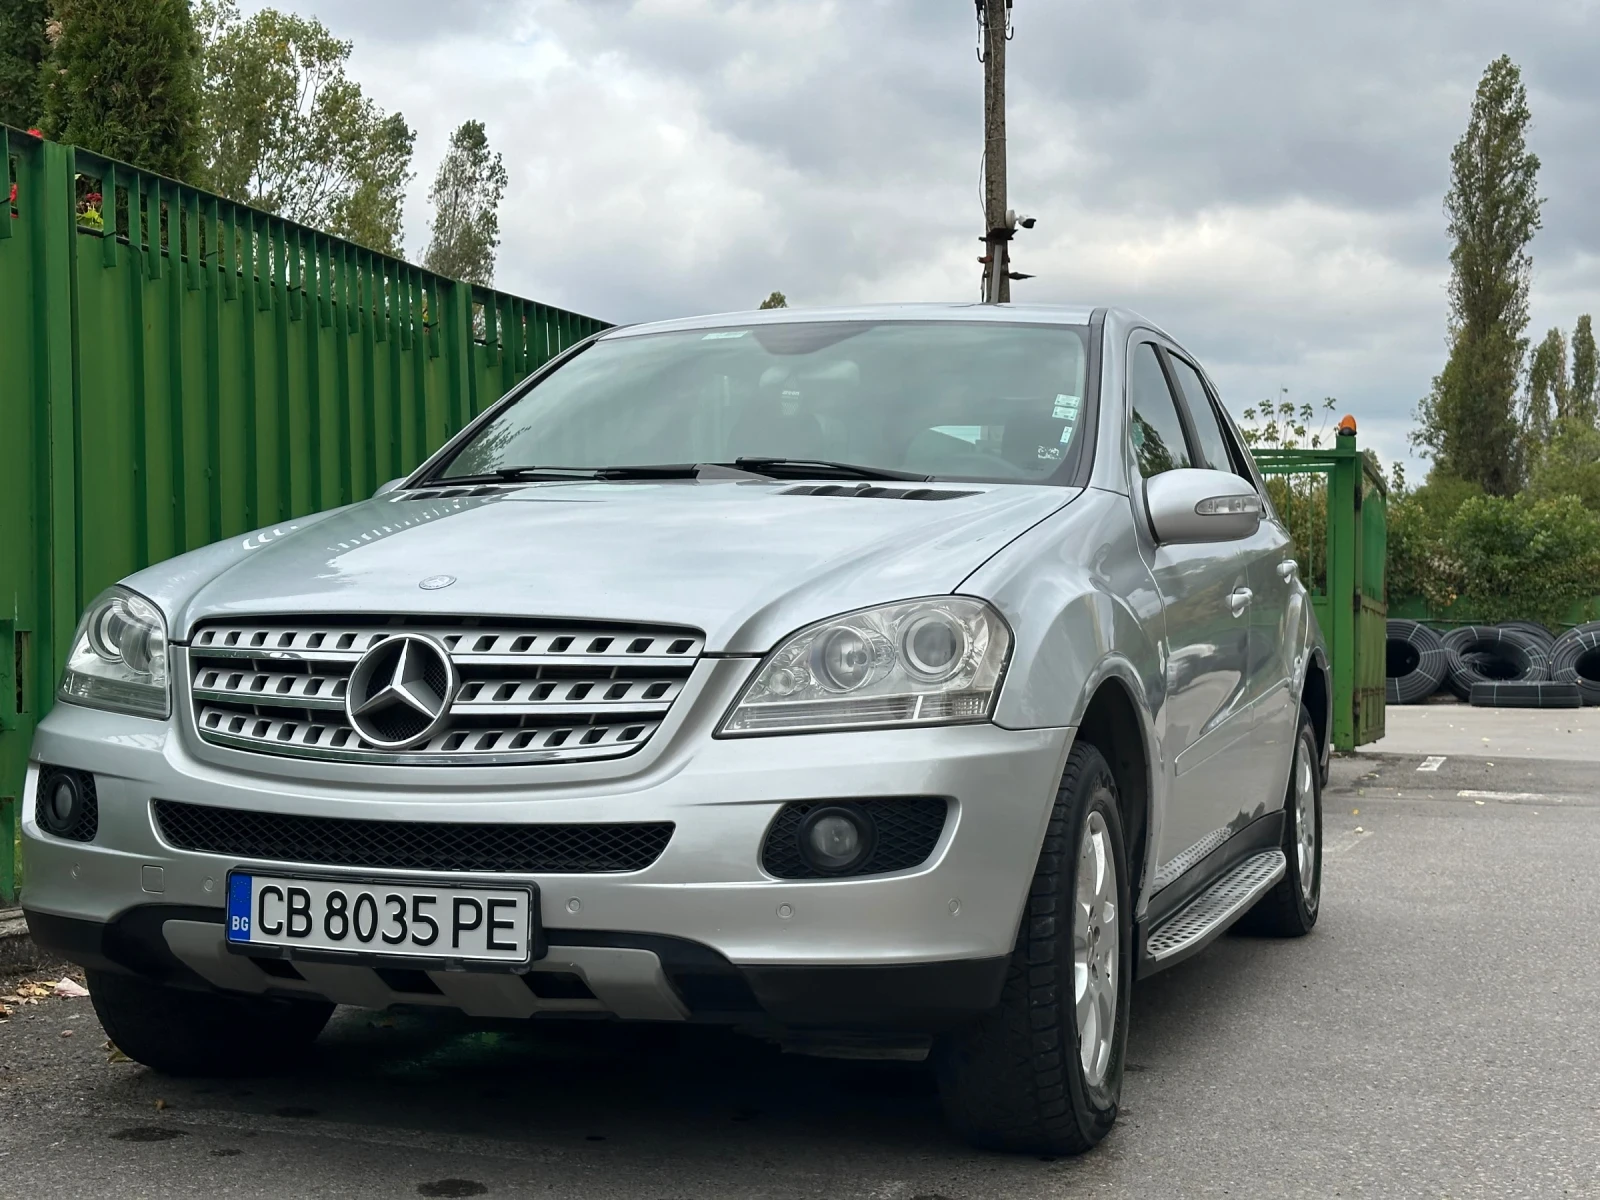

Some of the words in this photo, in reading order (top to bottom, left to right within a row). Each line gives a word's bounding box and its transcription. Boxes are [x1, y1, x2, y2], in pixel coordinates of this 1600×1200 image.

[232, 915, 249, 931] BG
[258, 884, 313, 937] CB
[323, 890, 439, 946] 8035
[452, 896, 518, 951] PE
